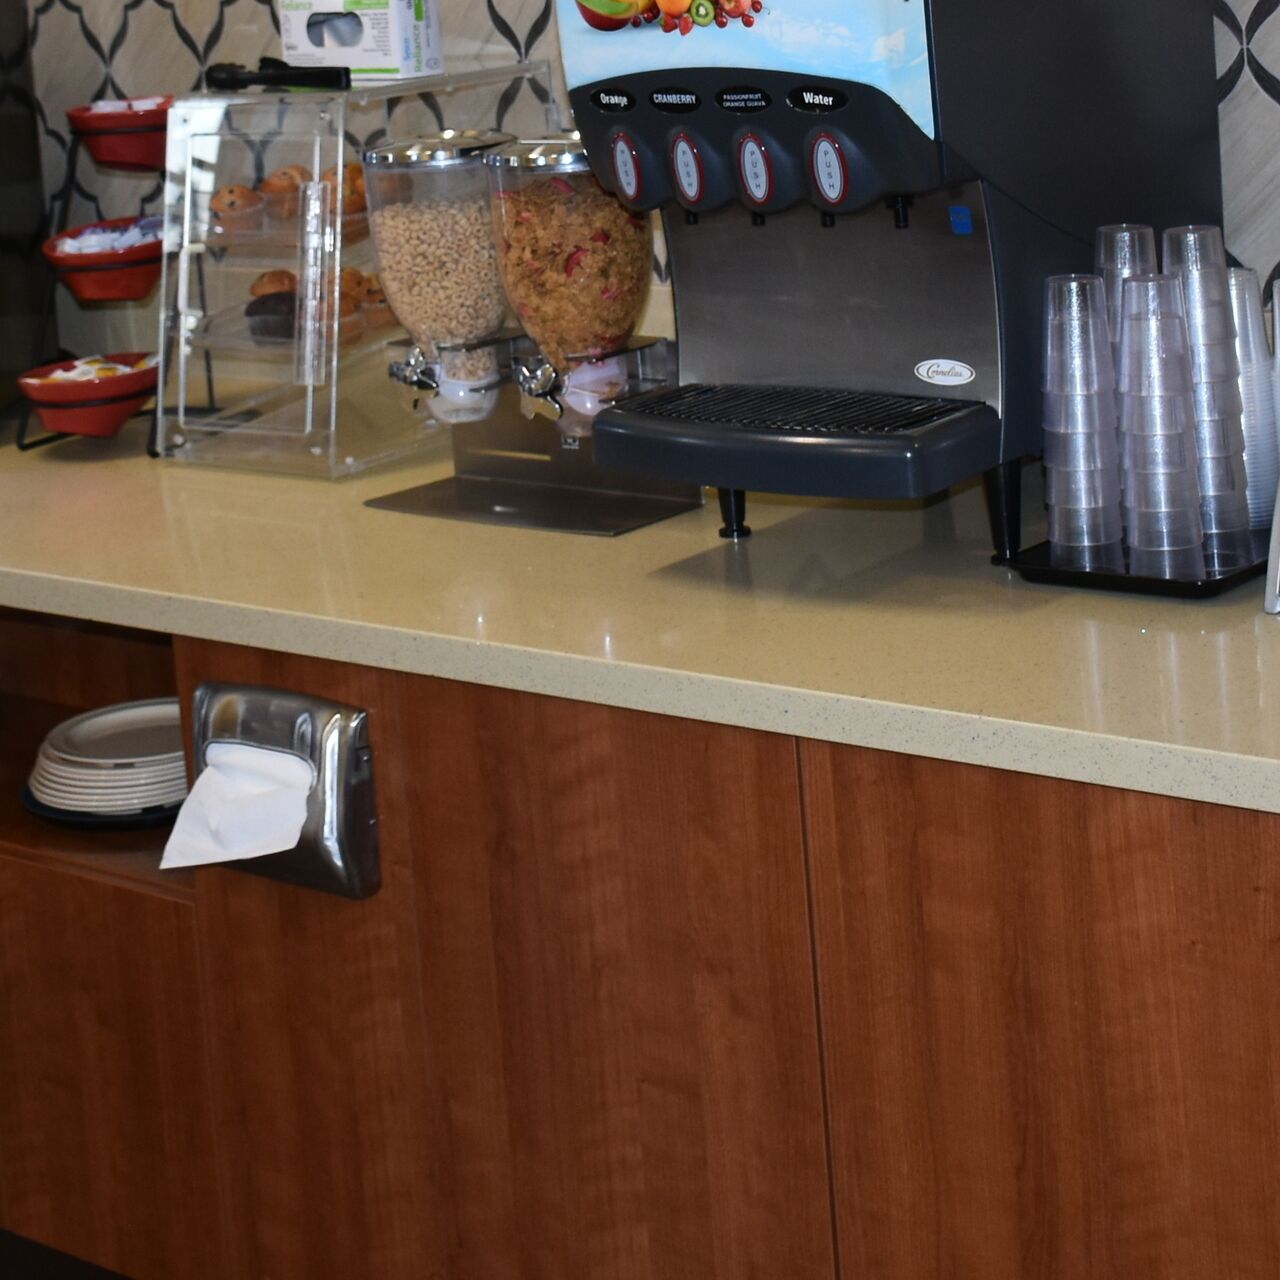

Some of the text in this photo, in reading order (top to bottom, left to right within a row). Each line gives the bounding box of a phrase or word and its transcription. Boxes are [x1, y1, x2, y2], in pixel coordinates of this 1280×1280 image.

[413, 23, 423, 72] Reliance
[600, 93, 628, 107] Orange
[653, 93, 697, 104] CRANBERRY
[802, 91, 834, 106] Water
[682, 150, 693, 187] PUSH
[750, 150, 762, 190] PUSH
[823, 150, 835, 190] PUSH
